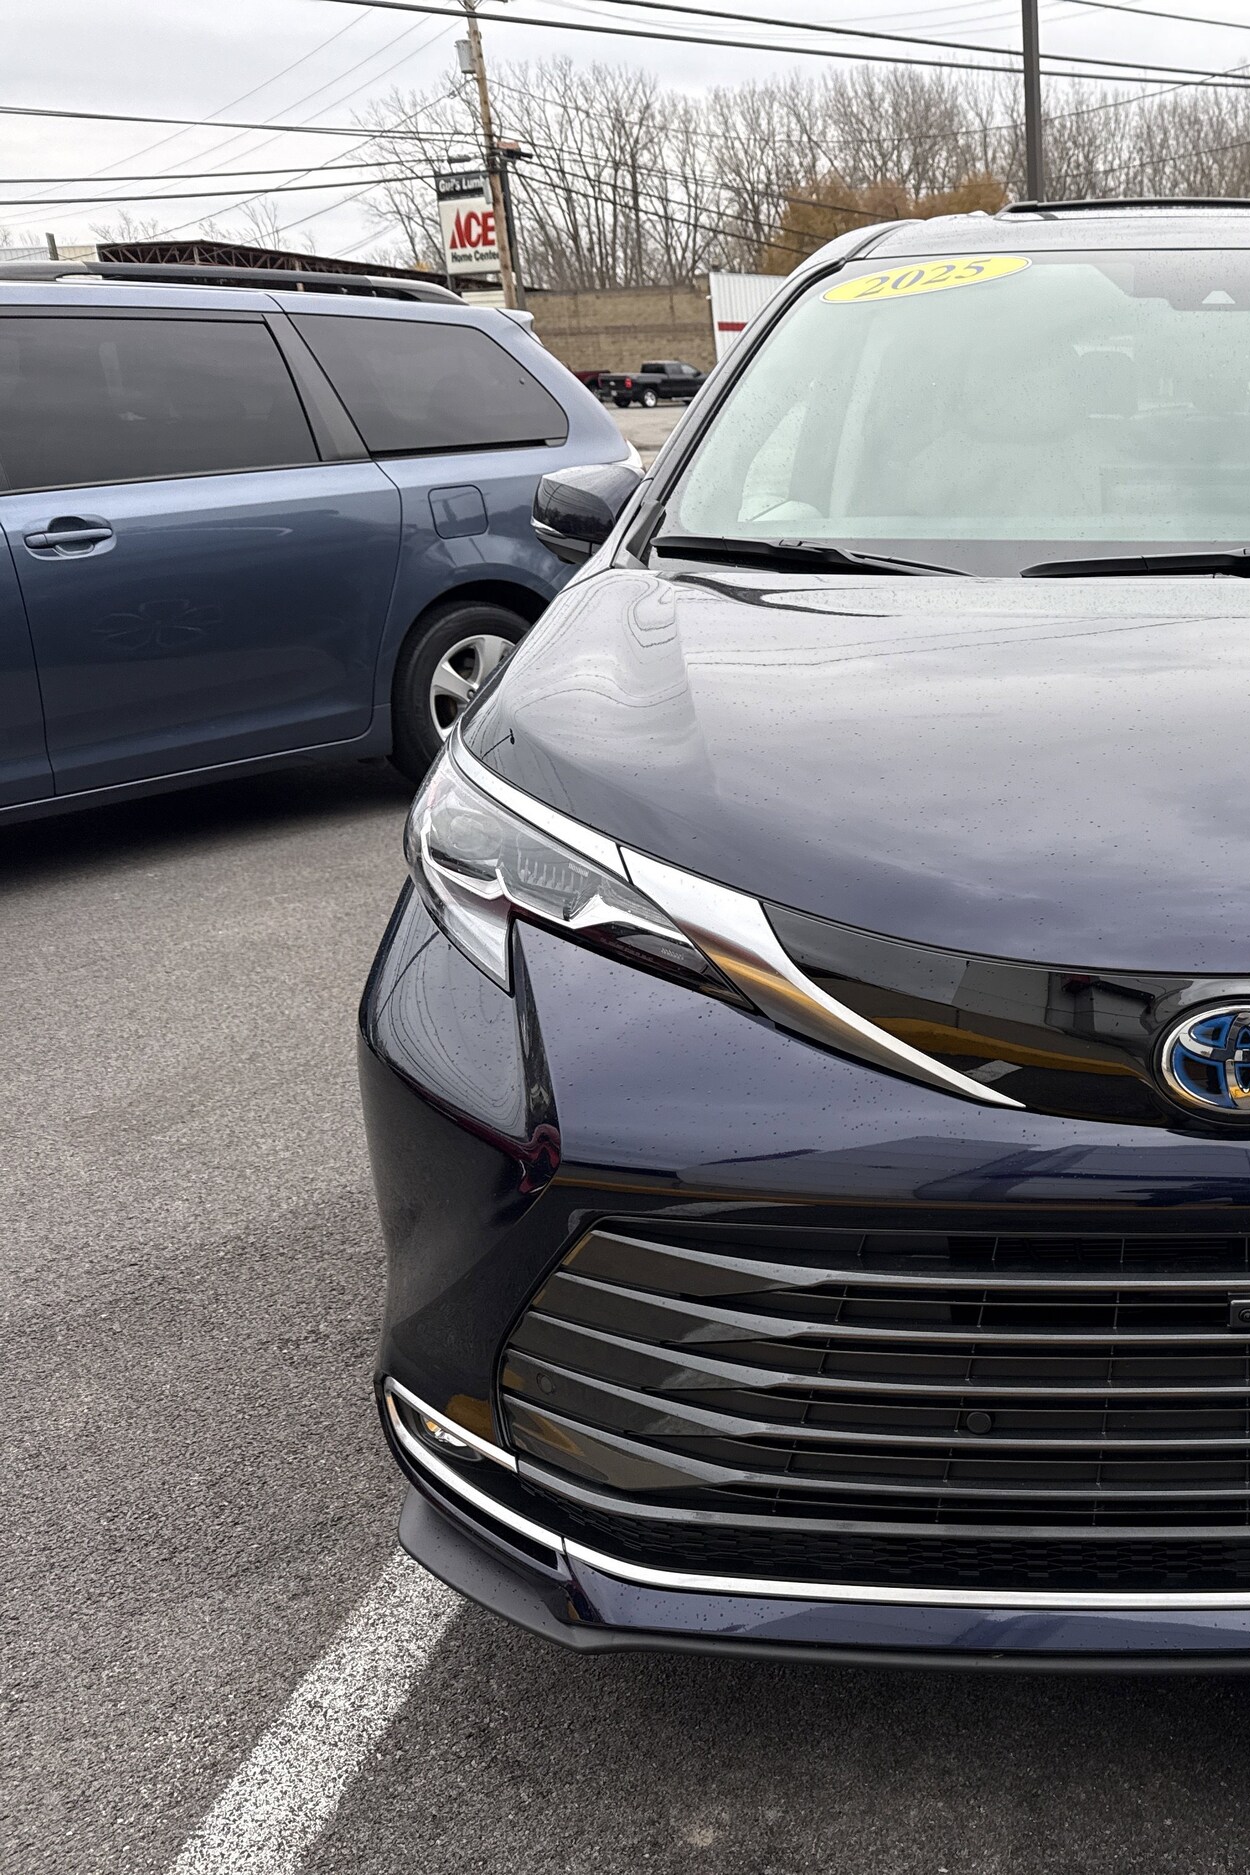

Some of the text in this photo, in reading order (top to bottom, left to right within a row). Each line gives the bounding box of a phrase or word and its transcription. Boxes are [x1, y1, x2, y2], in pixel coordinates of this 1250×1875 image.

[449, 208, 496, 249] ACE
[451, 252, 472, 263] Home
[855, 259, 992, 299] 2025
